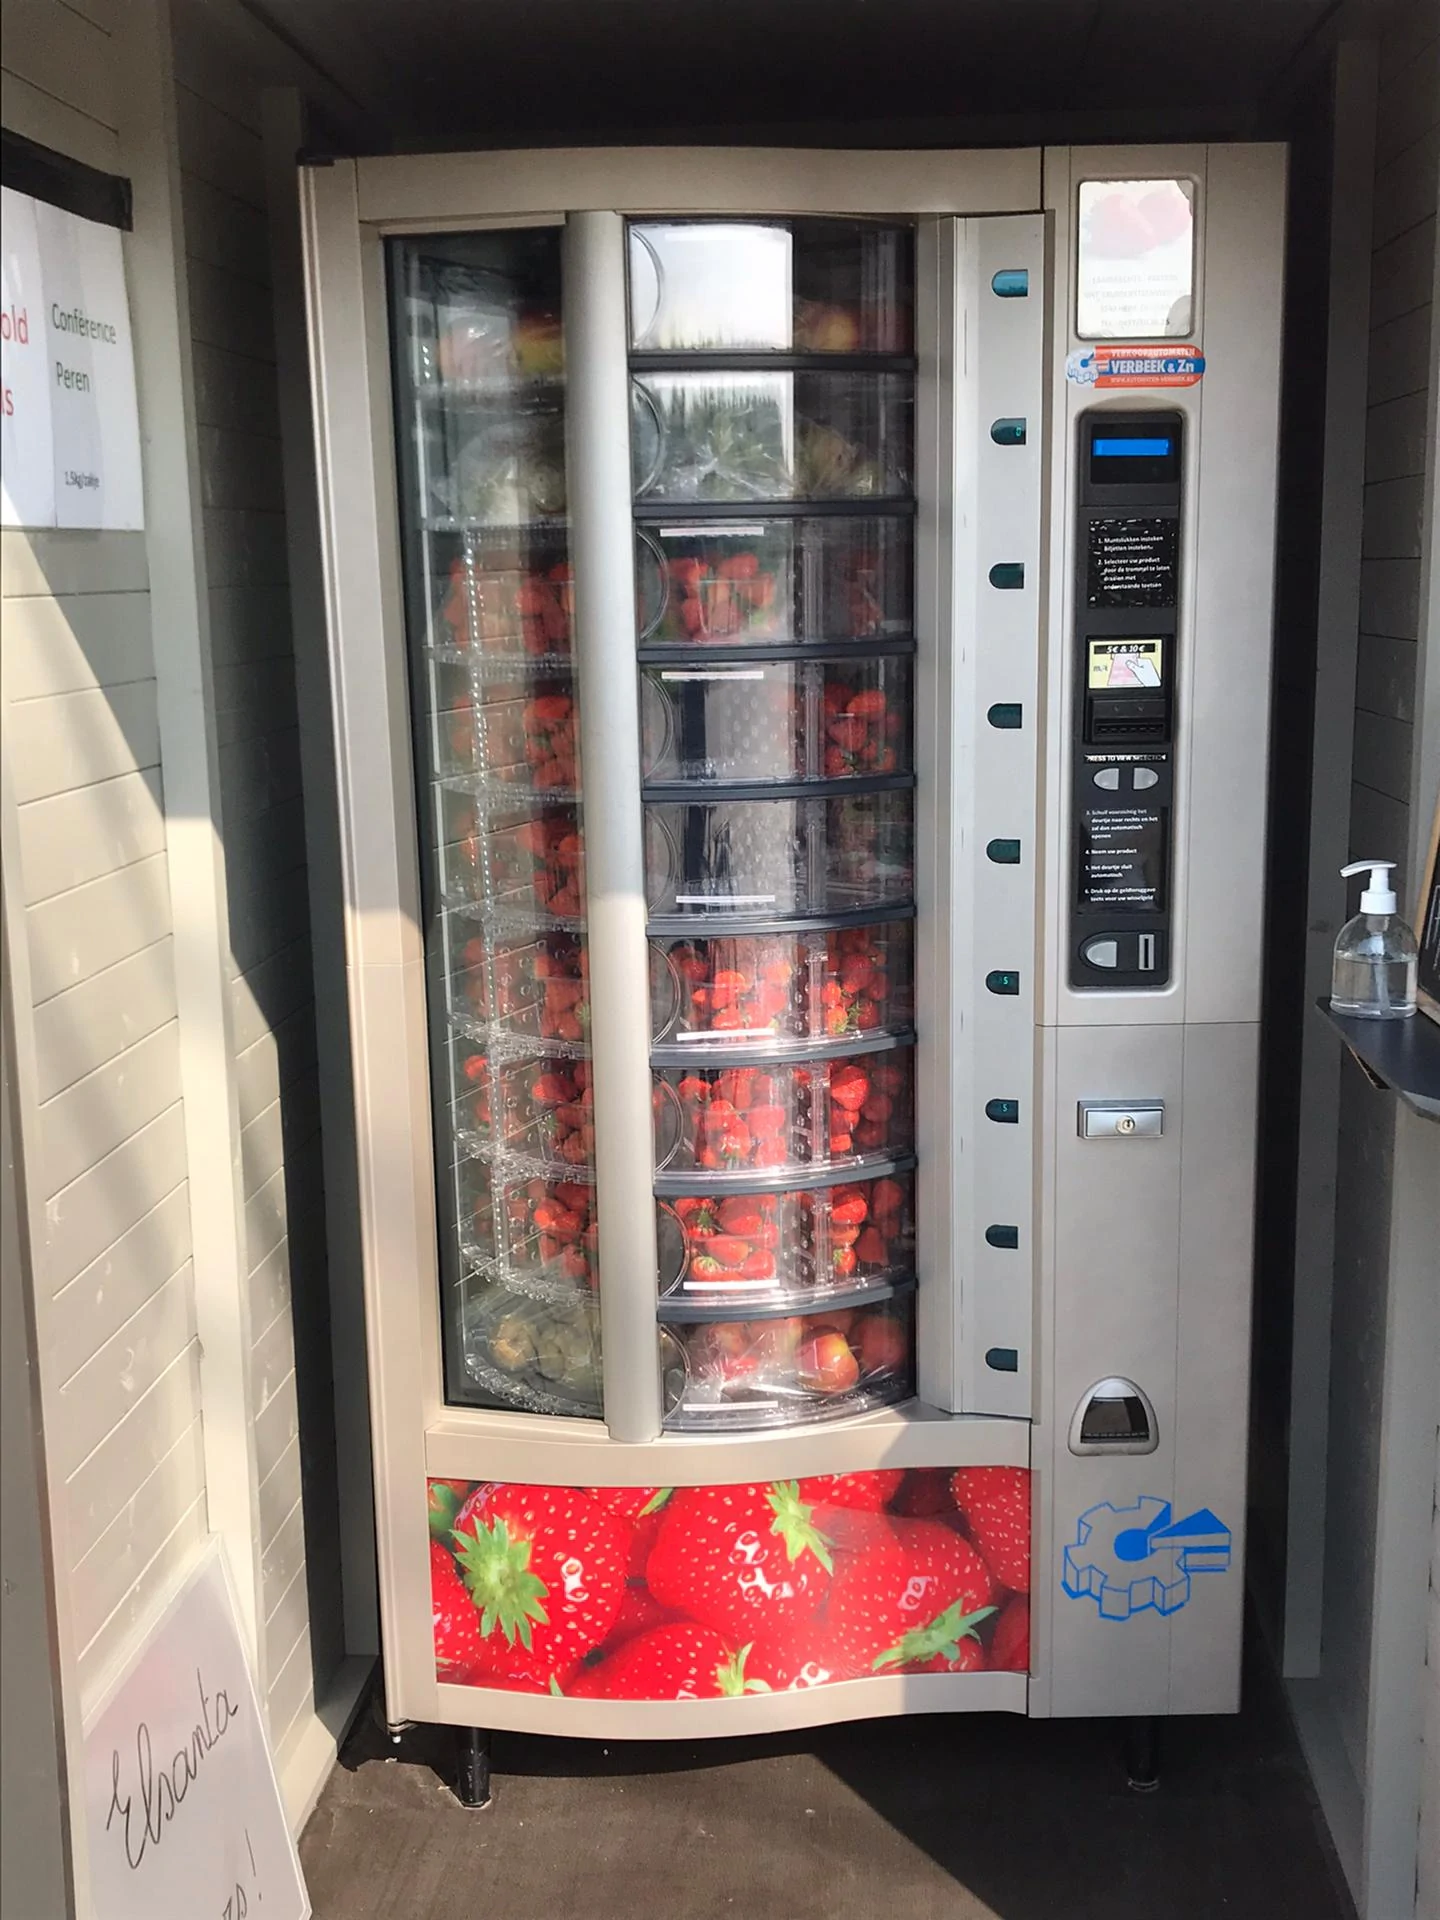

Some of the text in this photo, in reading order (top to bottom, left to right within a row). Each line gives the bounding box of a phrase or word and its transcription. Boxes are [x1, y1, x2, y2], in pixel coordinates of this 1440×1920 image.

[1111, 359, 1195, 373] VERBEEK & Zn
[55, 362, 90, 393] Peren
[1138, 557, 1160, 565] product
[1125, 565, 1149, 573] trommel
[106, 1667, 238, 1870] Elsanta
